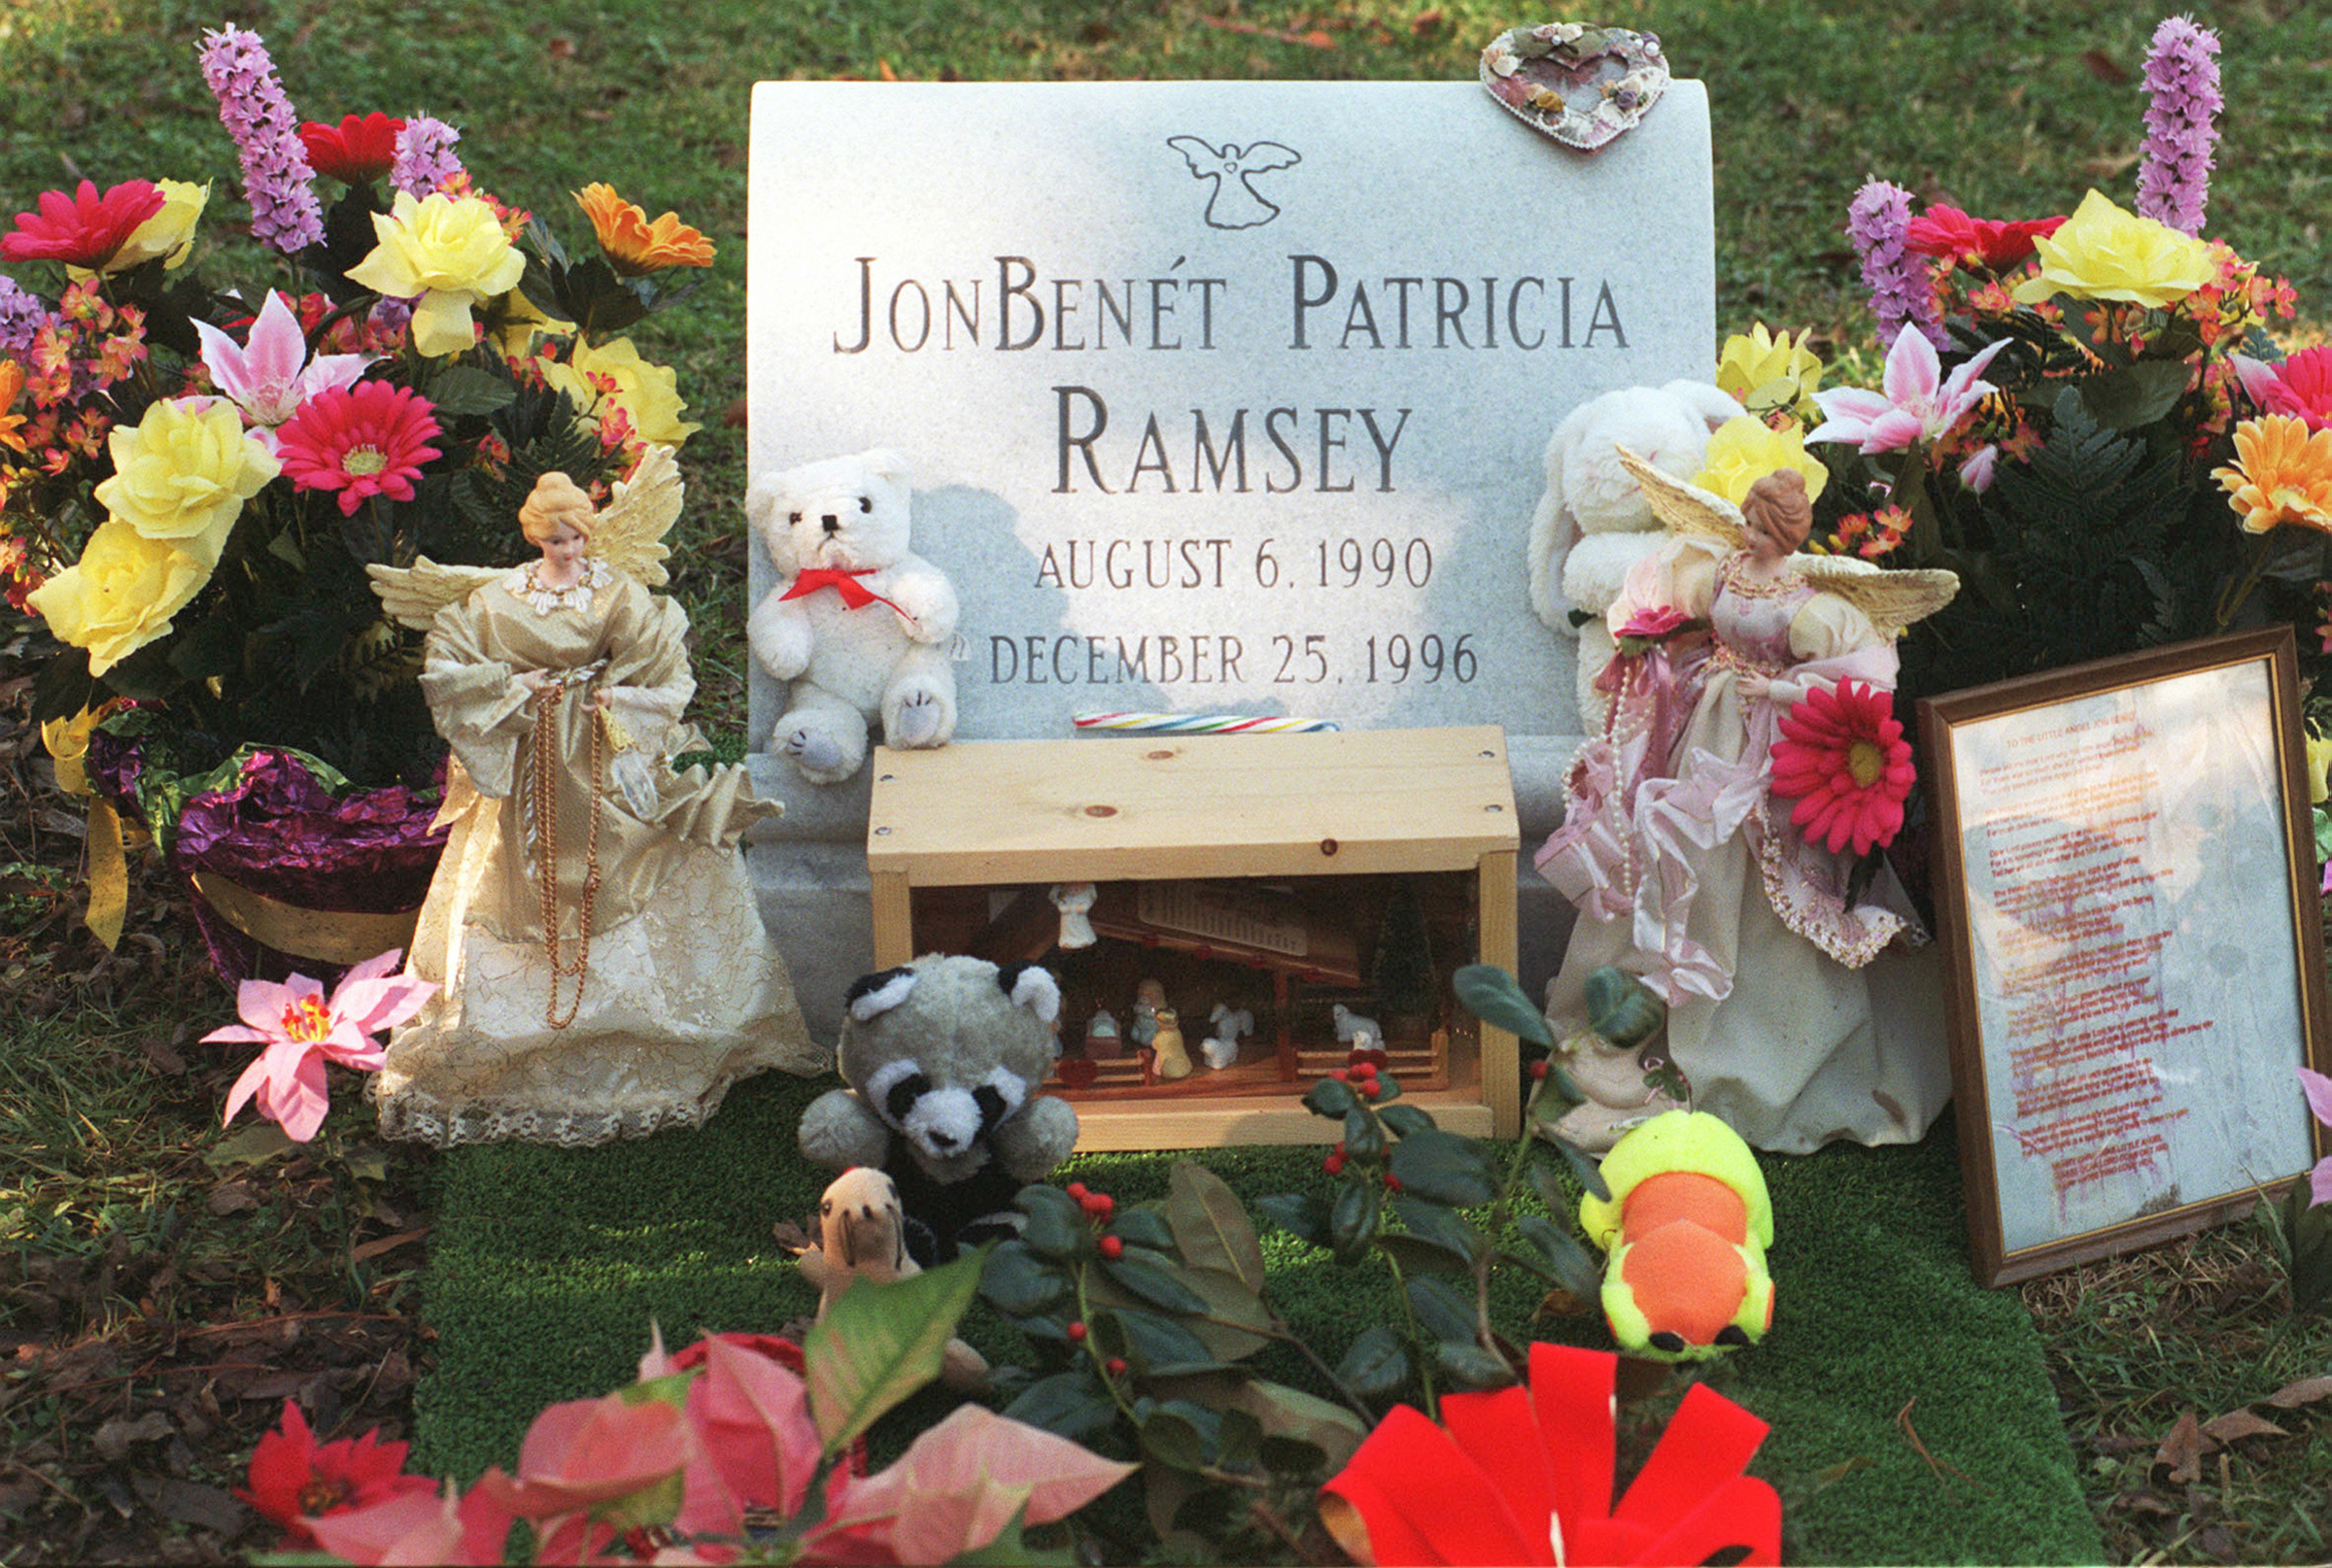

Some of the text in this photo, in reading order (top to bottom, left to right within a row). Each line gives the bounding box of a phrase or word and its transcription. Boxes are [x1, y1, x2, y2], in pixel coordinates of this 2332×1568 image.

[1286, 255, 1630, 351] PATRICIA
[1051, 386, 1412, 494] RAMSEY
[1034, 538, 1232, 590] AUGUST
[1318, 537, 1433, 589] 1990
[989, 634, 1244, 685] DECEMBER
[1366, 633, 1478, 685] 1996
